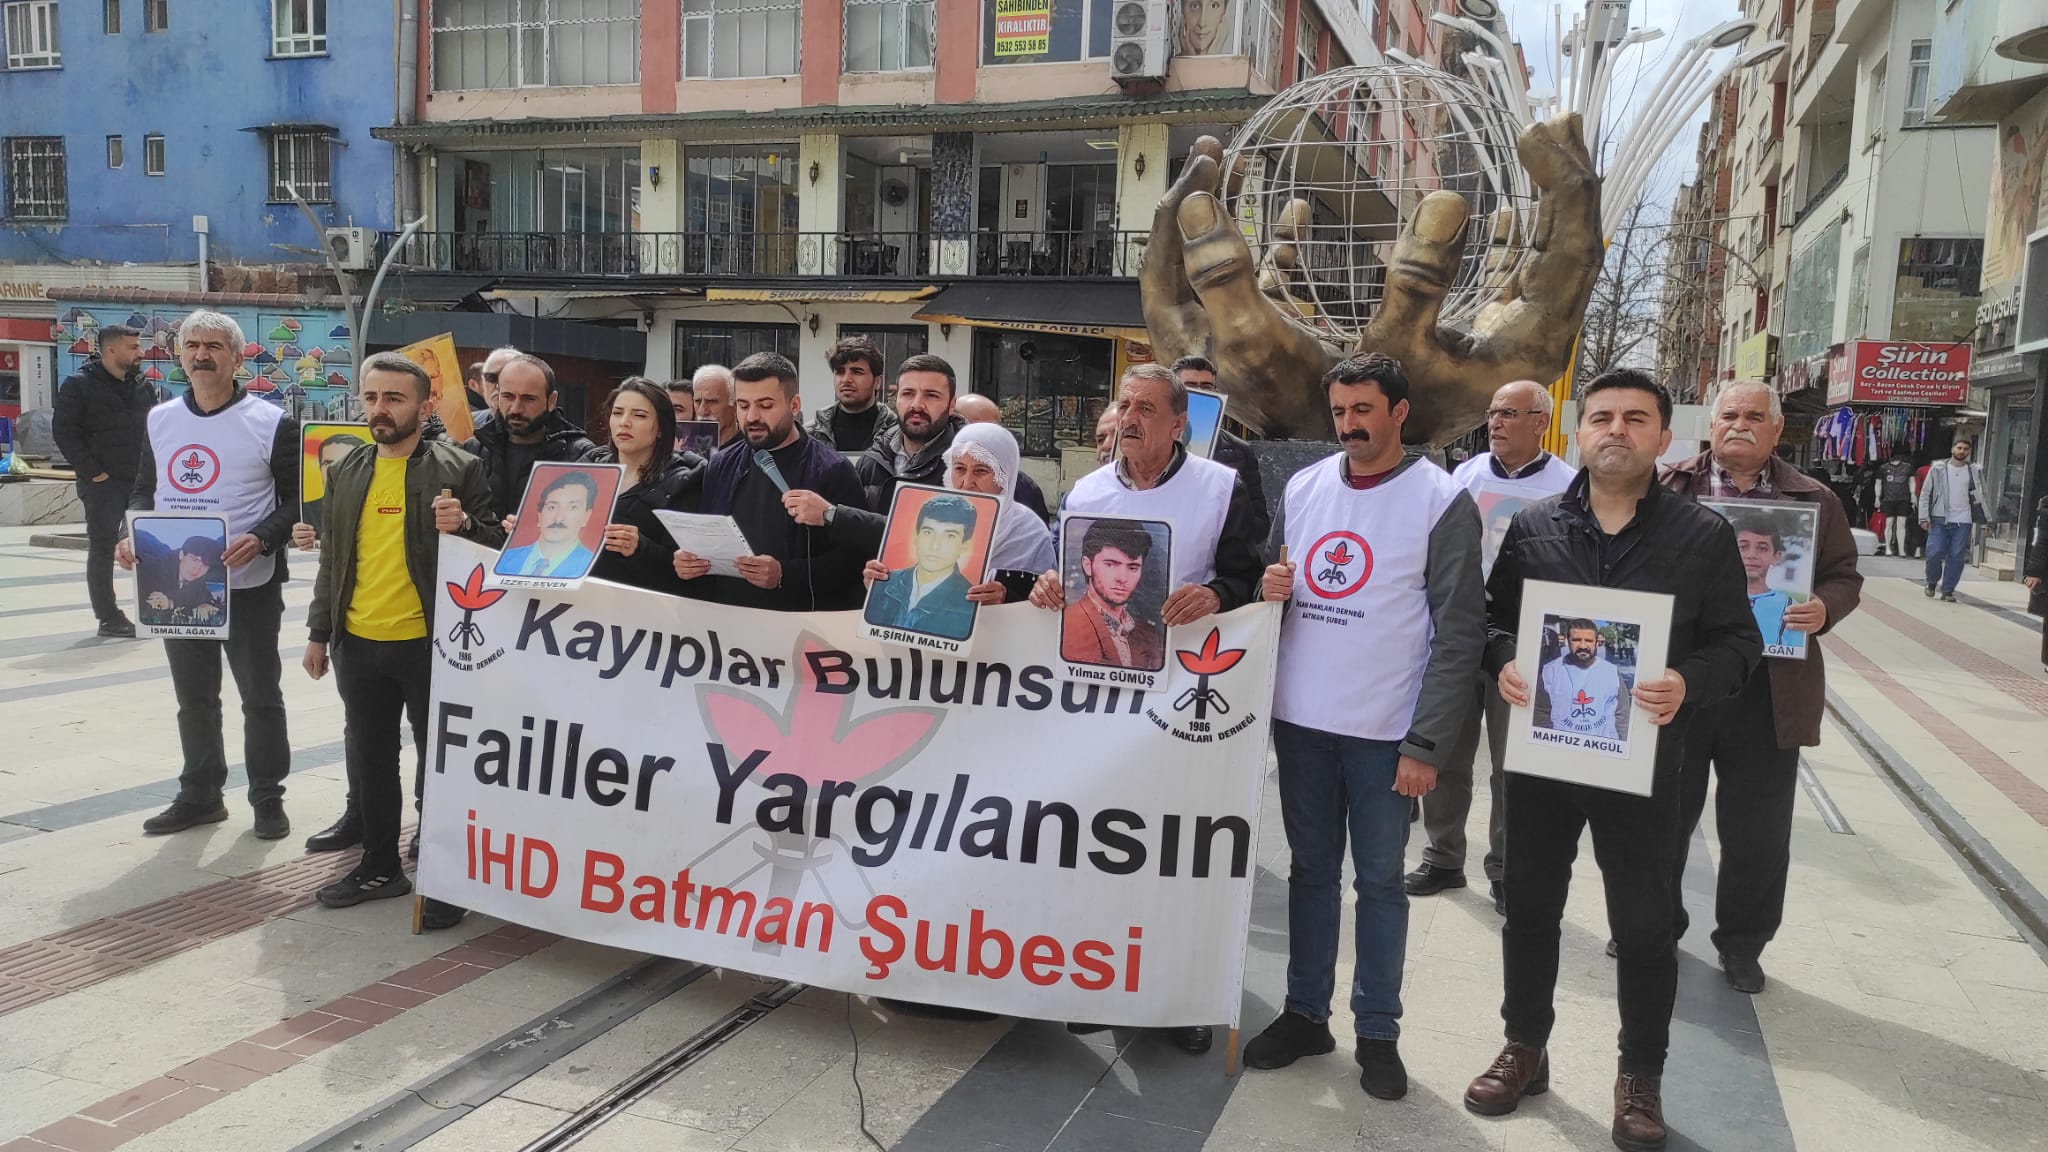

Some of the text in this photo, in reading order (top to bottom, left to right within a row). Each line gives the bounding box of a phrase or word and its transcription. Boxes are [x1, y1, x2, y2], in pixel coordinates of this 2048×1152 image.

[1014, 41, 1026, 51] 553
[1876, 345, 1948, 367] Şirin
[1861, 365, 1961, 381] Collection
[500, 578, 530, 587] İZZET
[151, 626, 216, 636] İSMAİL AĞAYA
[870, 628, 959, 652] M.ŞİRİN MALTU
[515, 598, 786, 689] Kayıplar
[1762, 645, 1795, 656] GAN
[1068, 666, 1155, 688] Yılmaz GÜMÜŞ
[1146, 707, 1257, 743] İNSAN HAKLARI DERNEĞİ
[1188, 721, 1211, 732] 1986
[1532, 730, 1580, 747] MAHFUZ
[434, 701, 1251, 879] Failler Yargılansın
[466, 808, 1143, 993] İHD Batman Şubesi
